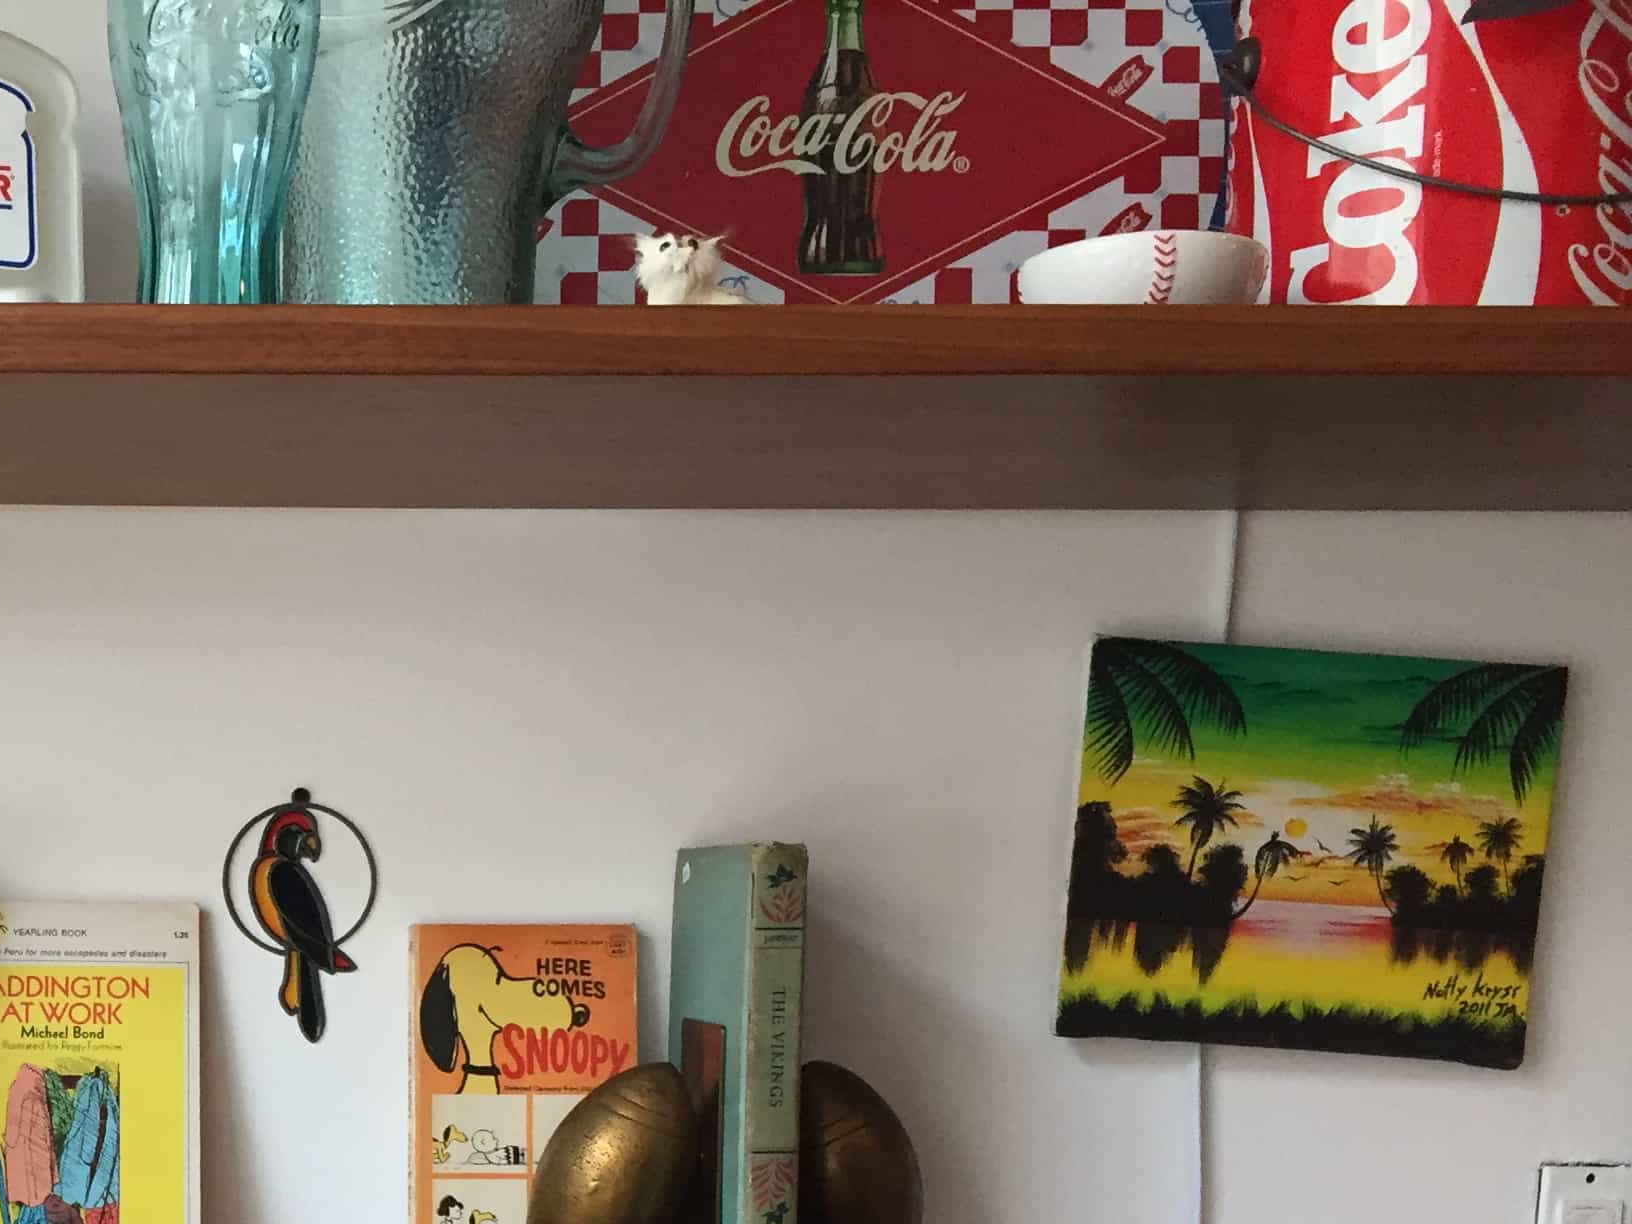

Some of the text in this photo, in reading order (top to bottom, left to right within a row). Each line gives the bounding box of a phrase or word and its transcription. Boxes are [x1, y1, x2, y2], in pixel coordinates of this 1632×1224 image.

[715, 91, 967, 177] Coca-Cola
[1287, 0, 1431, 306] Coke
[13, 927, 58, 937] YEARLING
[61, 928, 88, 937] BOOK
[536, 957, 592, 977] HERE
[532, 978, 606, 999] COMES
[0, 1001, 123, 1025] AT WORK
[1458, 1000, 1491, 1016] 2011
[20, 1025, 104, 1039] Michael Bond
[500, 1022, 630, 1080] SNOOPY
[768, 985, 786, 1109] THE VIKINGS
